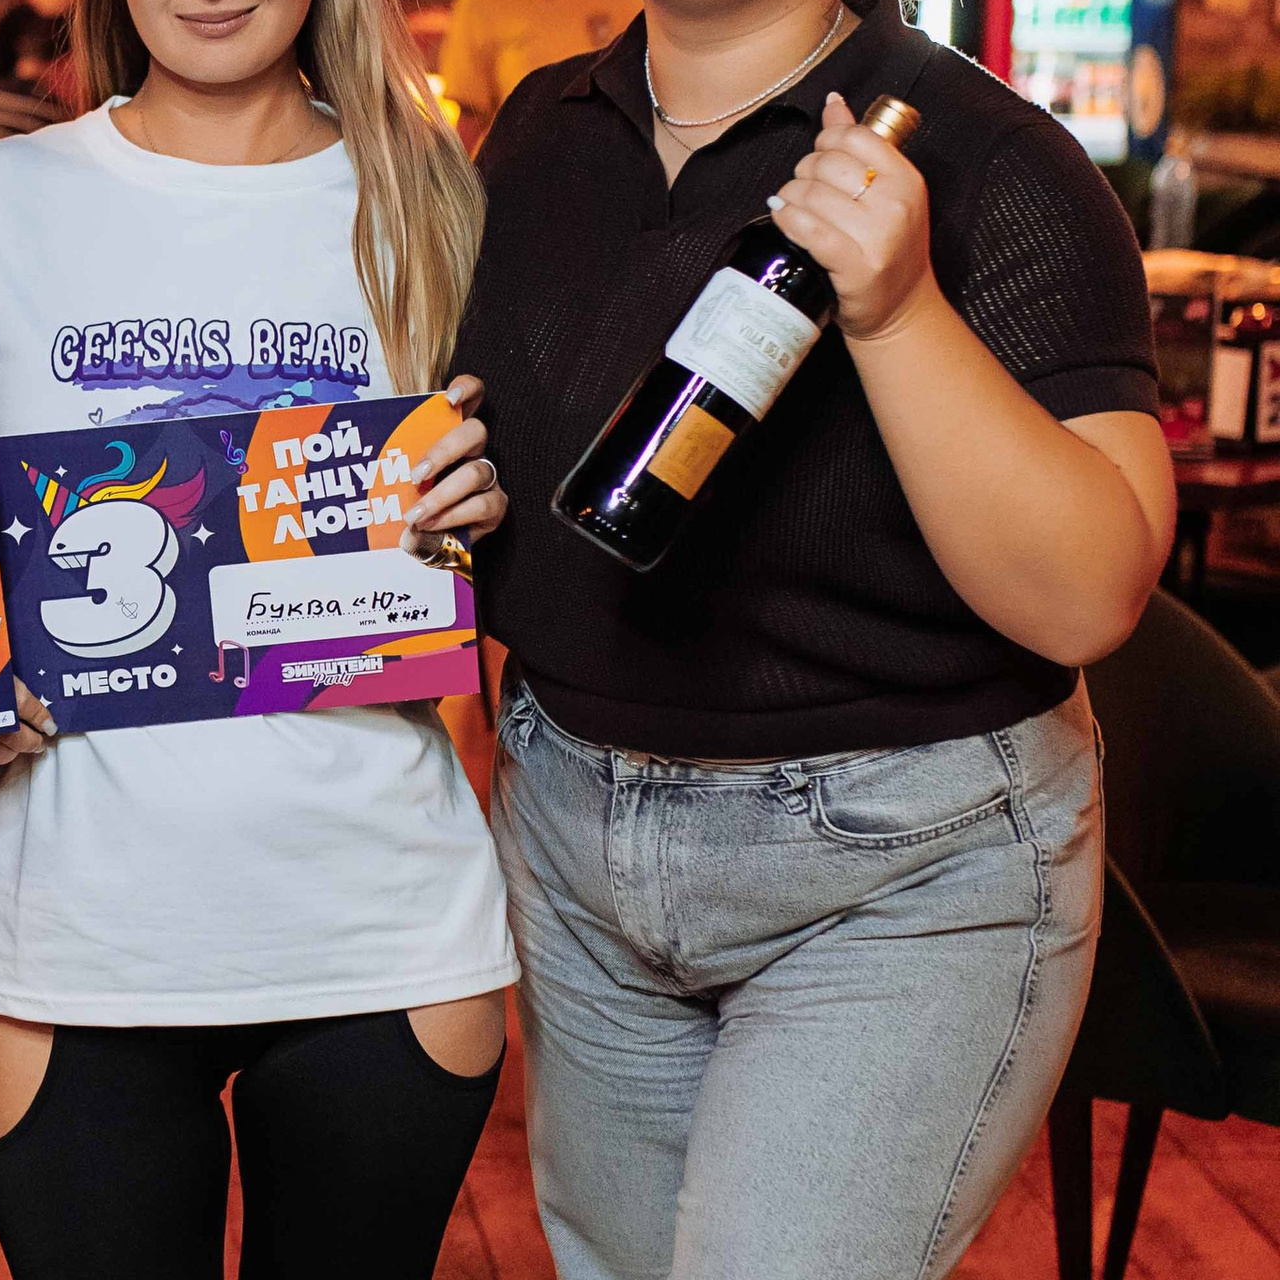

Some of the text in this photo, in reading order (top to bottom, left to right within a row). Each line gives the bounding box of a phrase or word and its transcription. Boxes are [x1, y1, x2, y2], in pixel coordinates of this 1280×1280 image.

[51, 319, 371, 387] GEESAS BEAR
[272, 420, 373, 469] ПОЙ,
[236, 448, 418, 513] ТАНЦУЙ
[273, 494, 403, 545] ЛЮБИ
[41, 500, 179, 658] 3
[247, 592, 342, 620] Буква
[246, 627, 282, 637] КОМАНДА
[62, 664, 177, 697] МЕСТО
[282, 653, 384, 683] ЭЙНШТЕЙН
[313, 672, 356, 688] Party
